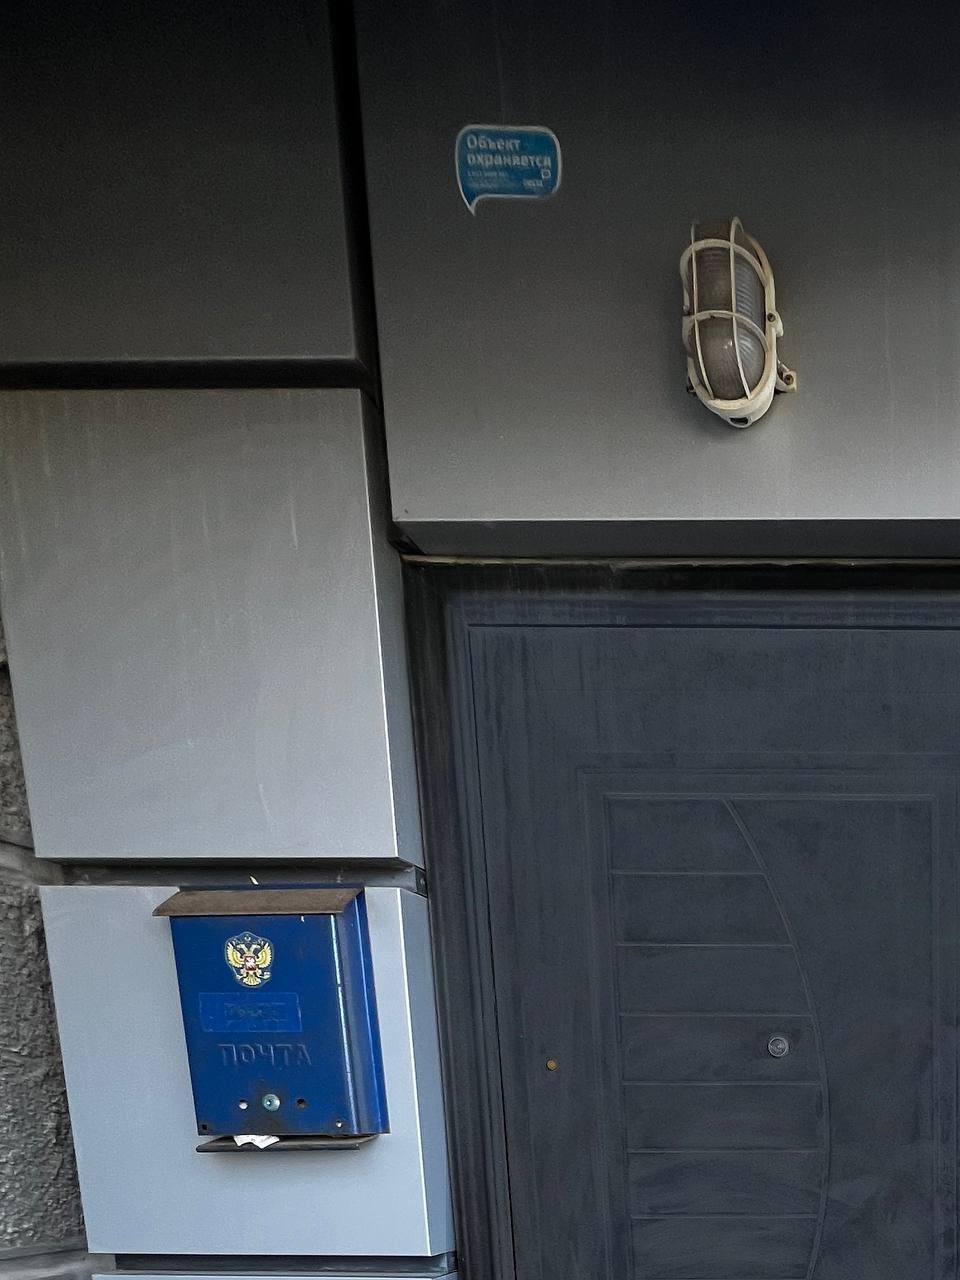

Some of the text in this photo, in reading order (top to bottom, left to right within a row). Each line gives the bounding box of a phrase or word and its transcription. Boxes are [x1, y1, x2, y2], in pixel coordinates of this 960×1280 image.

[467, 134, 520, 151] Объект
[467, 153, 551, 169] охраняется
[218, 1043, 312, 1066] ПОЧТА
